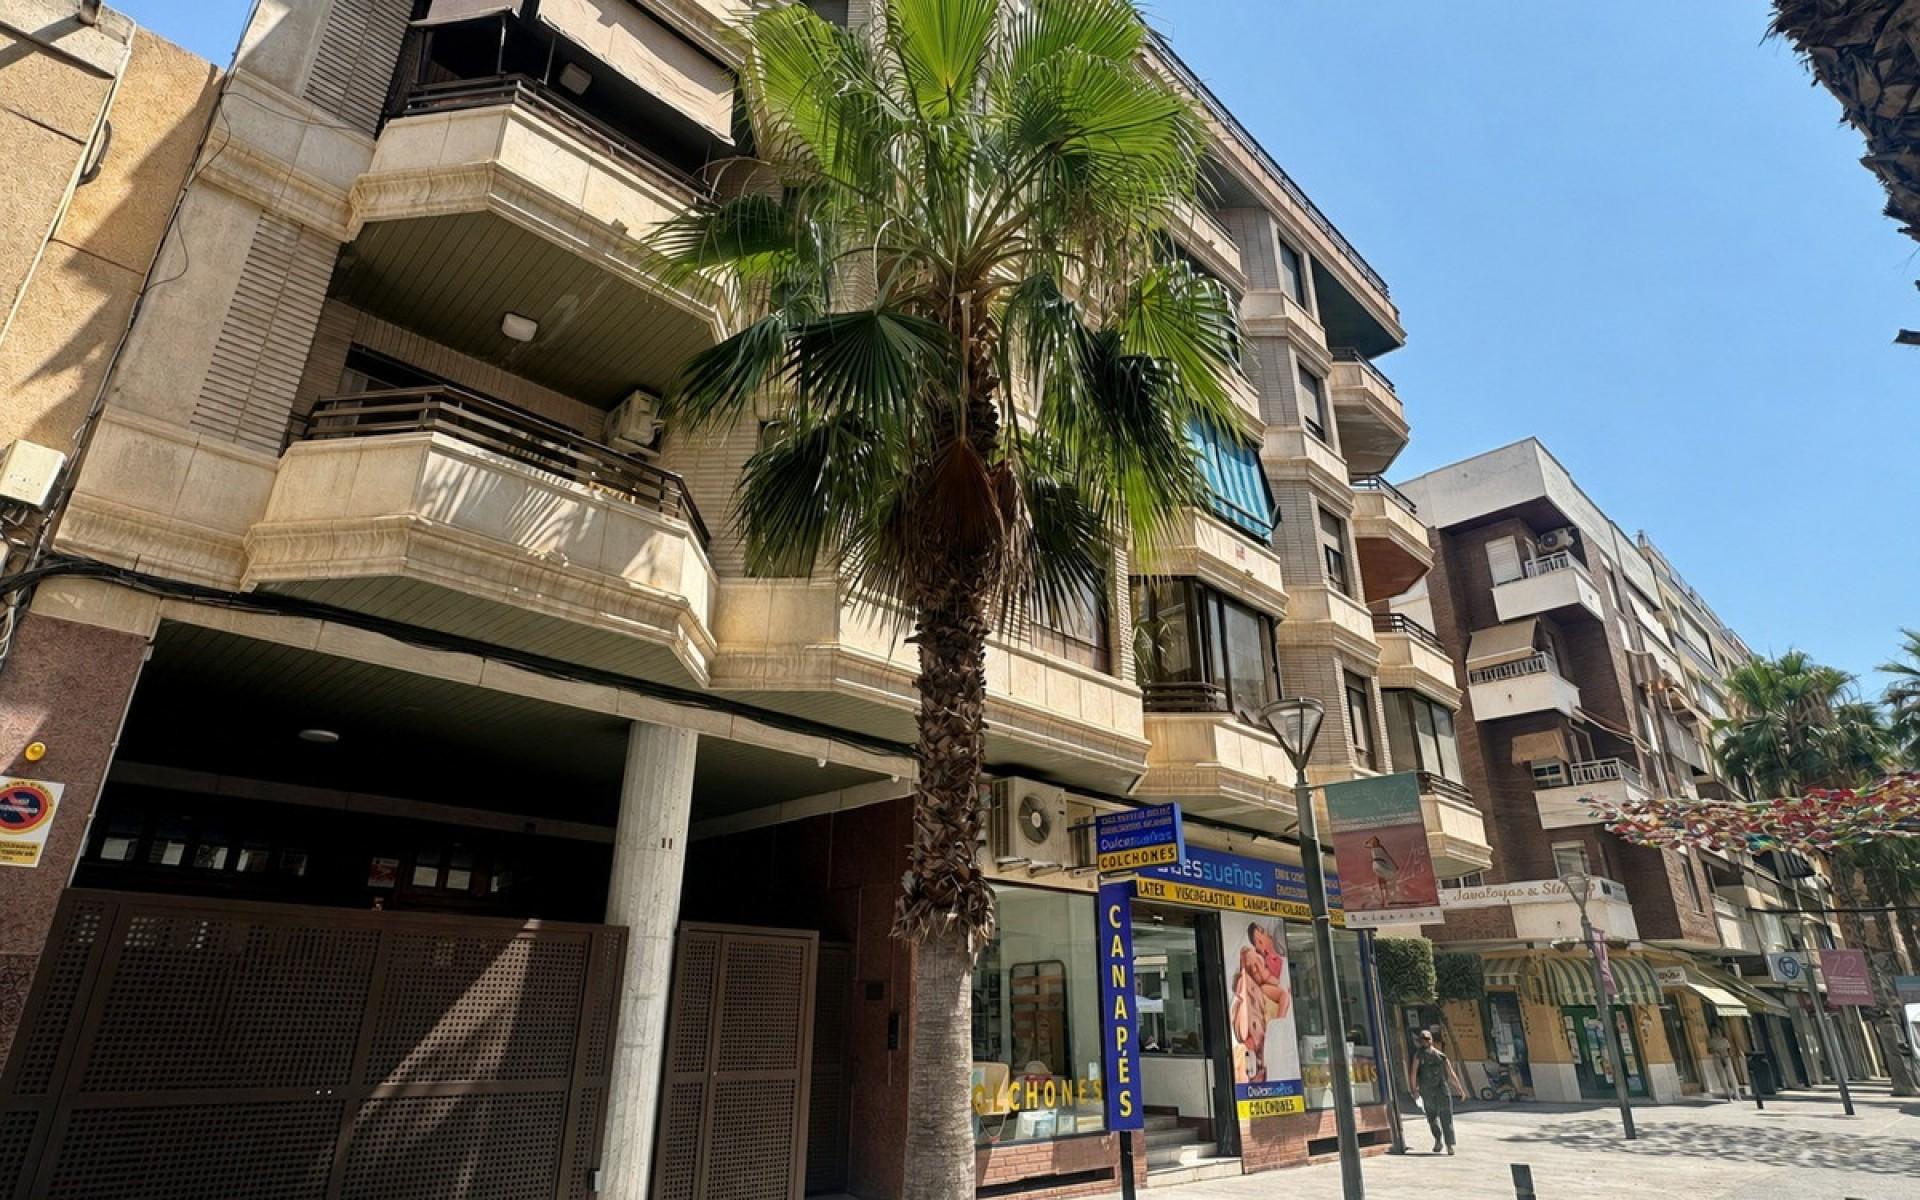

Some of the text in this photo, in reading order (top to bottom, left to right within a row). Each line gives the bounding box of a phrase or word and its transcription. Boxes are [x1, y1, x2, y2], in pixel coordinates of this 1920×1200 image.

[1101, 847, 1175, 870] COLCHONES
[1139, 880, 1166, 897] LATEX
[972, 1079, 1103, 1115] OLCHONES
